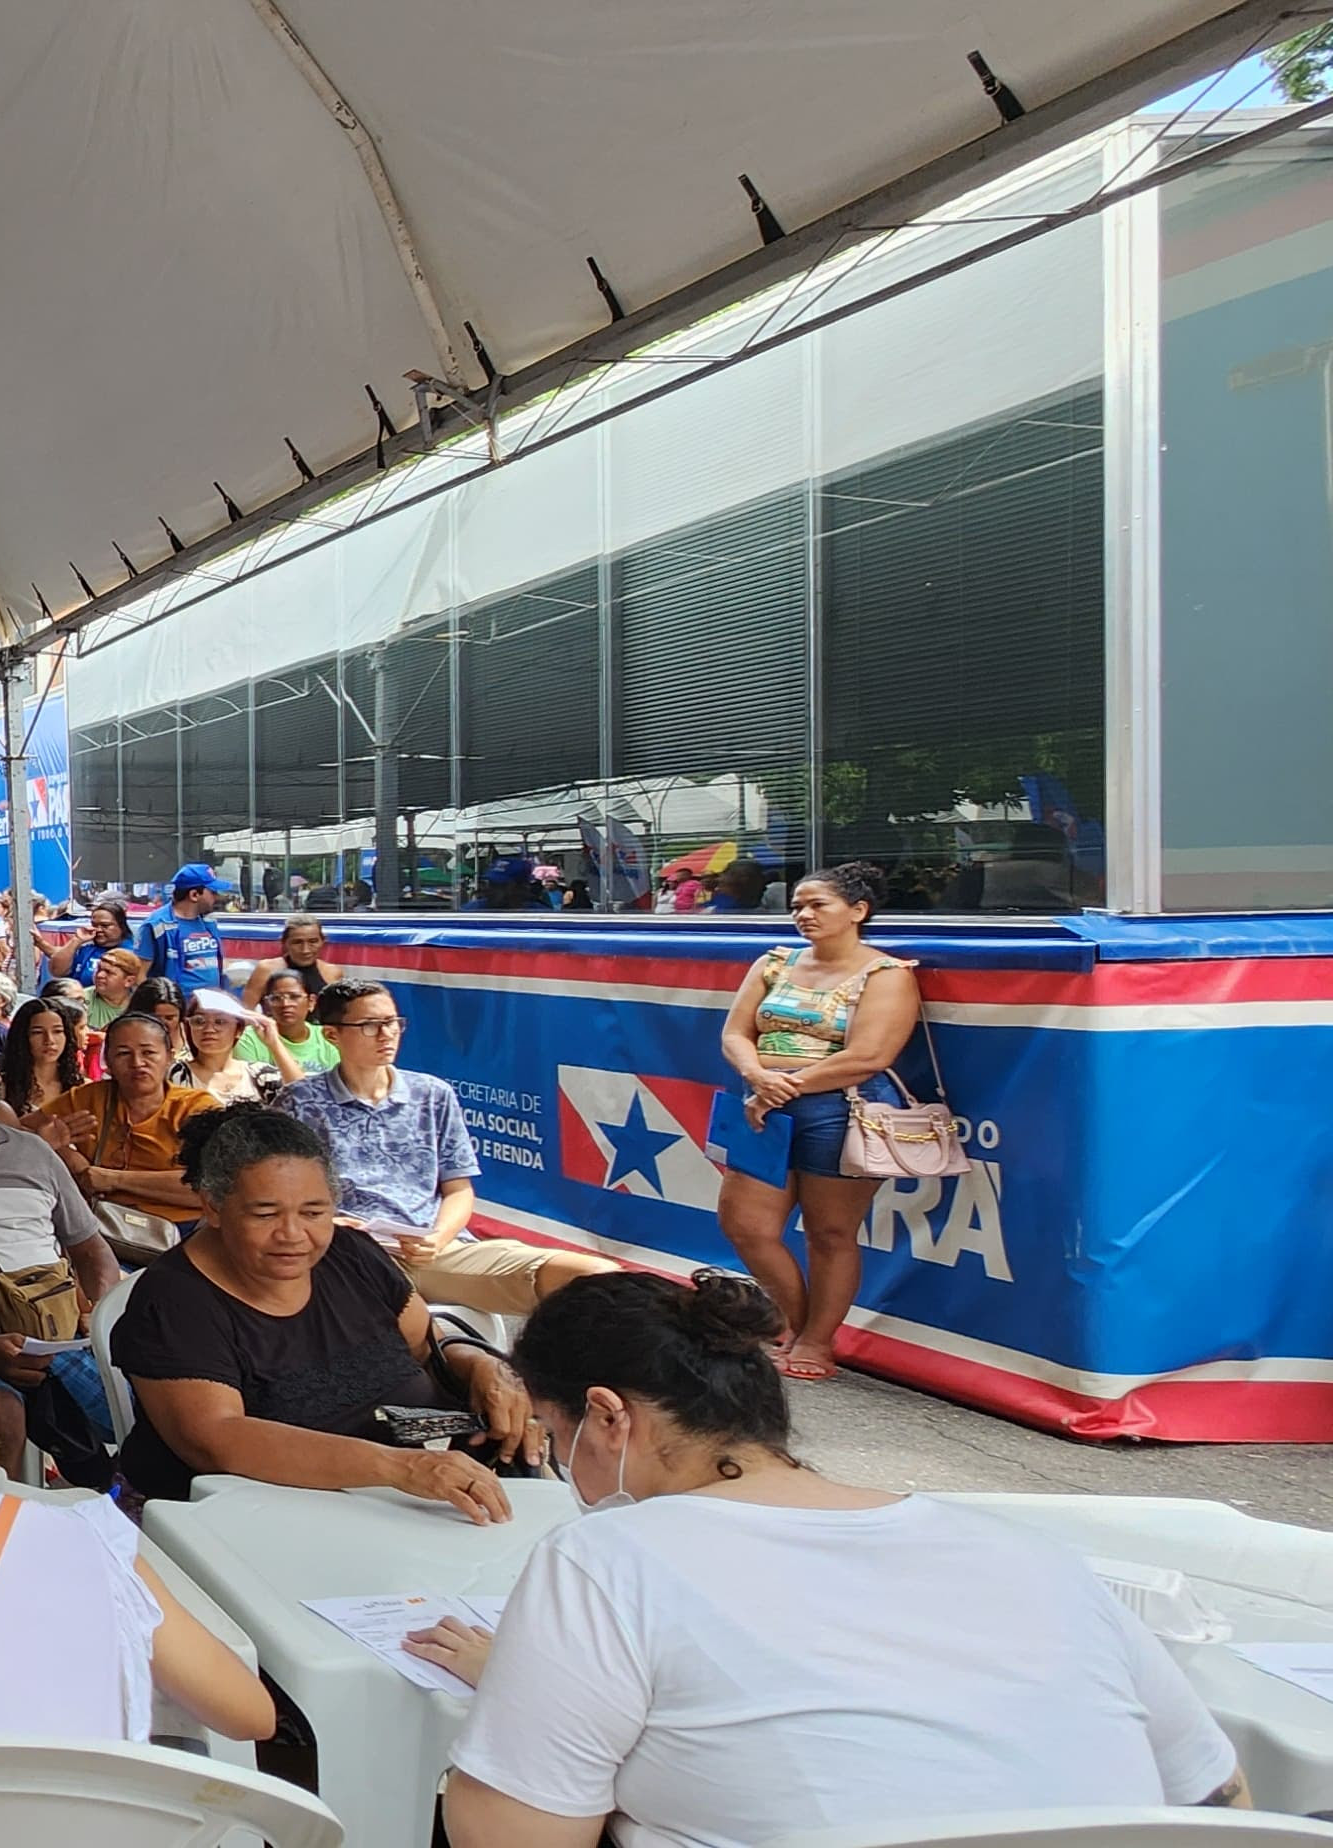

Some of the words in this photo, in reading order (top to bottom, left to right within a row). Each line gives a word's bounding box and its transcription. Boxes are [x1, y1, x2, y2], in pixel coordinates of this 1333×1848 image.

[445, 1079, 520, 1110] ECRETARIA
[520, 1092, 542, 1115] DE
[487, 1112, 544, 1146] SOCIAL,
[482, 1138, 492, 1158] E
[492, 1141, 545, 1172] RENDA
